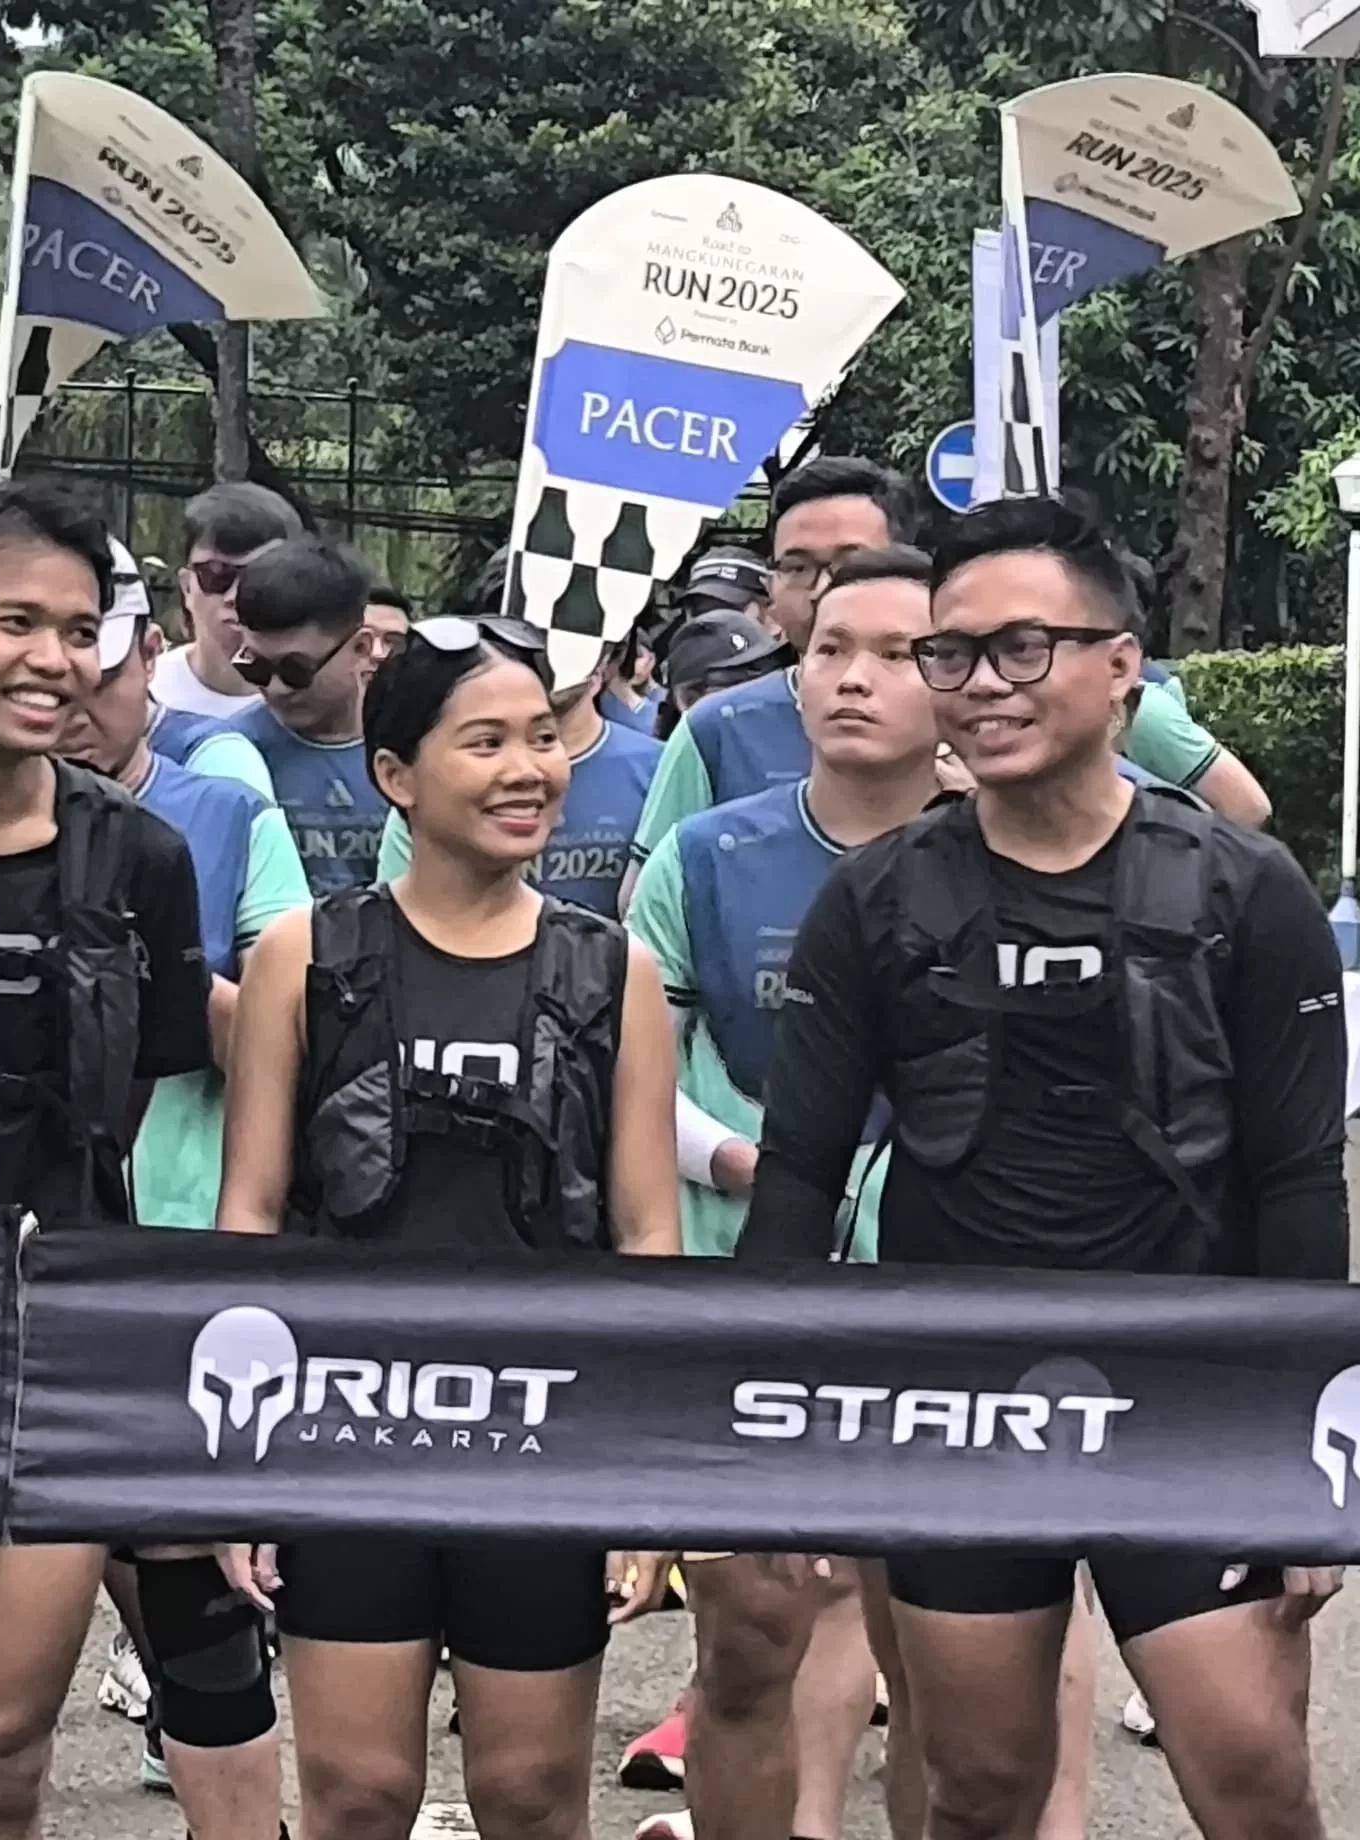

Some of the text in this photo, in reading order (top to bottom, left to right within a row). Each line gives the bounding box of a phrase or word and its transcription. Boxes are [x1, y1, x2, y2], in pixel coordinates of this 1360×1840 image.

[97, 146, 164, 204] RUN
[1064, 130, 1137, 172] RUN
[1128, 157, 1211, 201] 2025
[643, 260, 712, 304] RUN
[715, 275, 801, 320] 2025
[580, 390, 741, 464] PACER
[548, 846, 624, 881] 2025
[303, 1357, 578, 1426] RIOT
[732, 1381, 1134, 1452] START
[299, 1423, 543, 1453] JAKARTA
